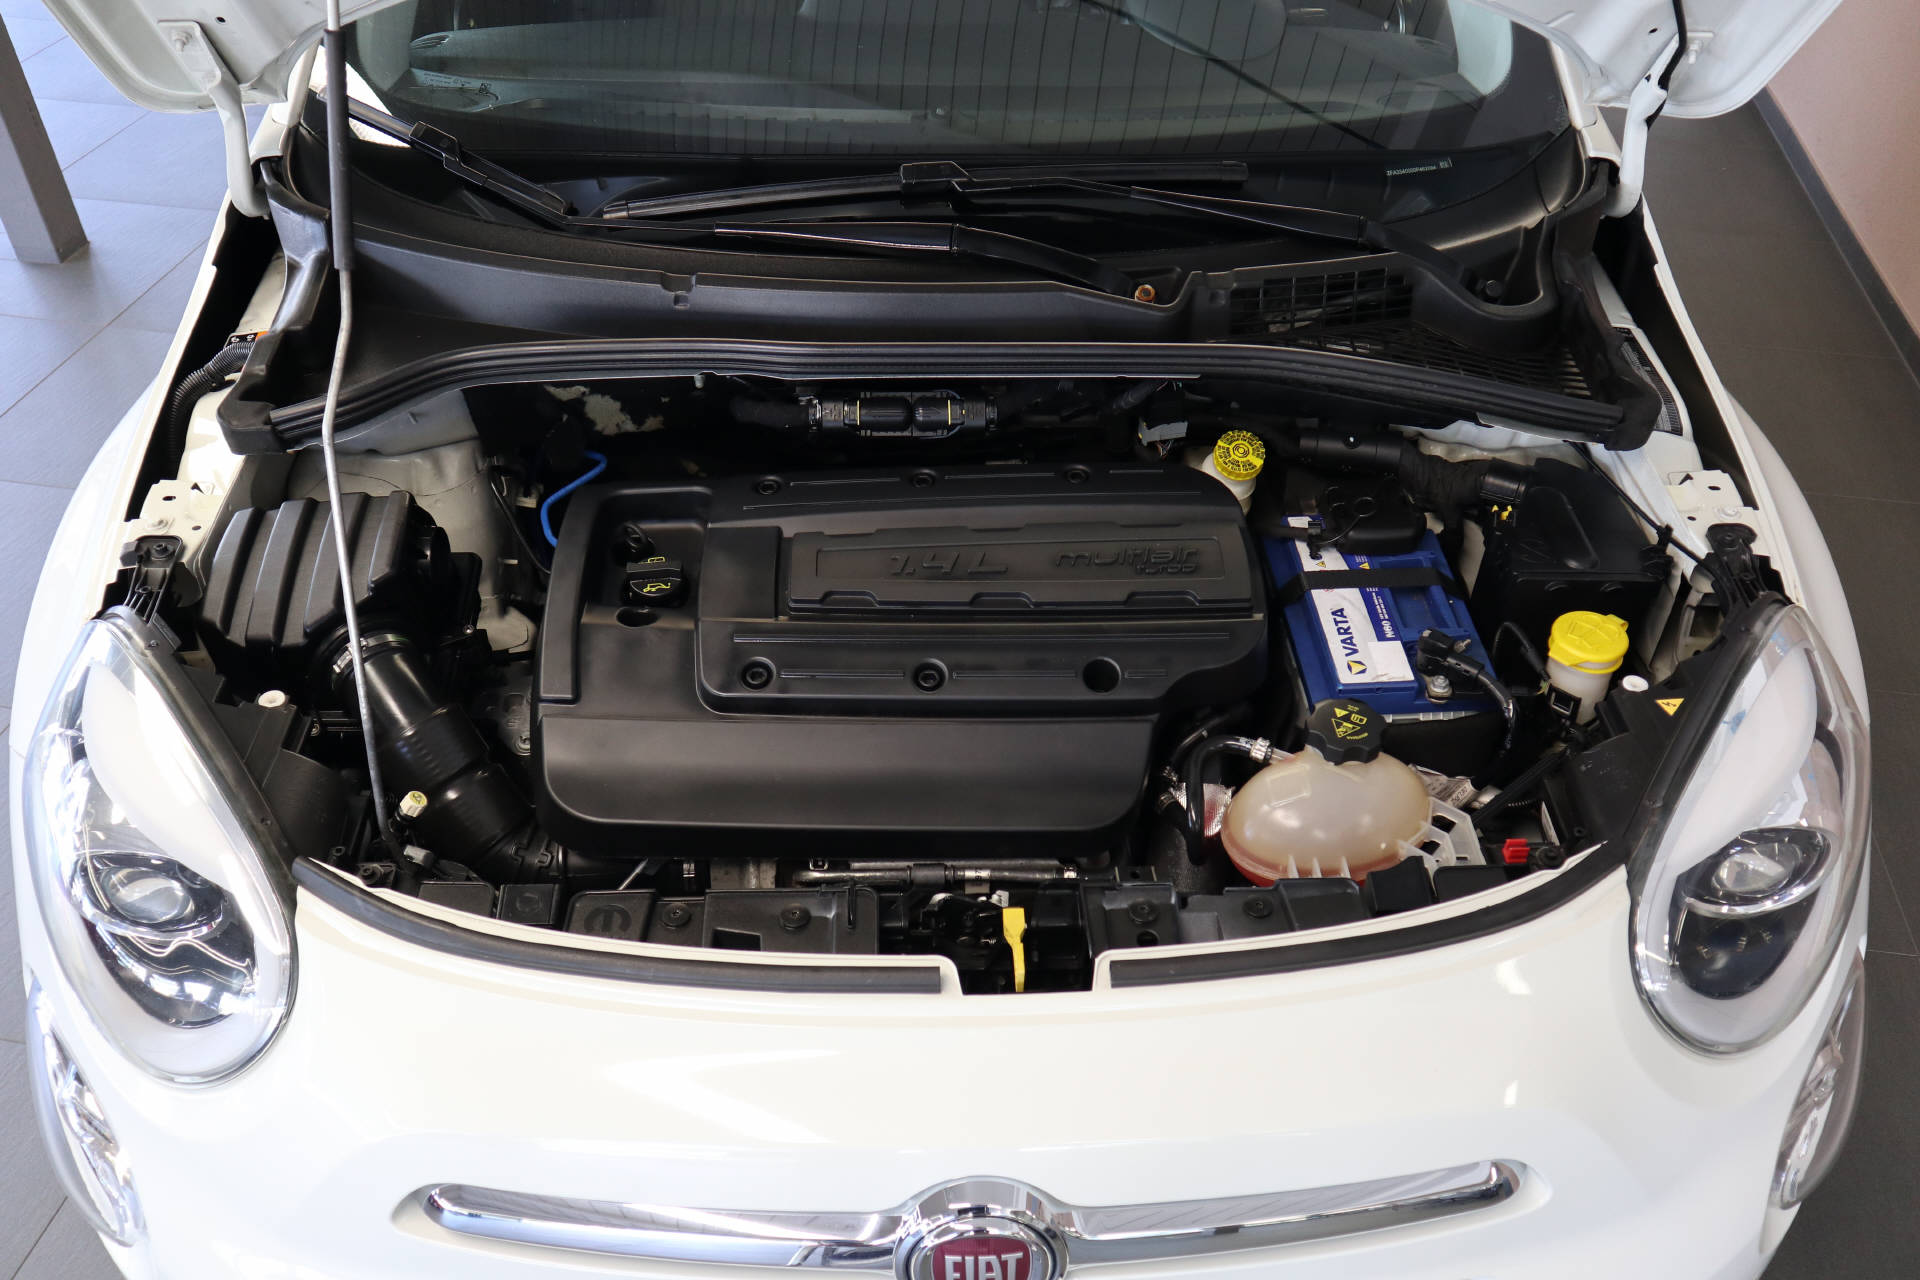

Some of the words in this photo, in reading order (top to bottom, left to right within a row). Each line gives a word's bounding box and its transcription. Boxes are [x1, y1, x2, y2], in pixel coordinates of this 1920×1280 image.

[968, 552, 1009, 576] L
[1331, 607, 1359, 657] VARTA
[1381, 620, 1396, 639] N60
[944, 1252, 1024, 1280] FIAT
